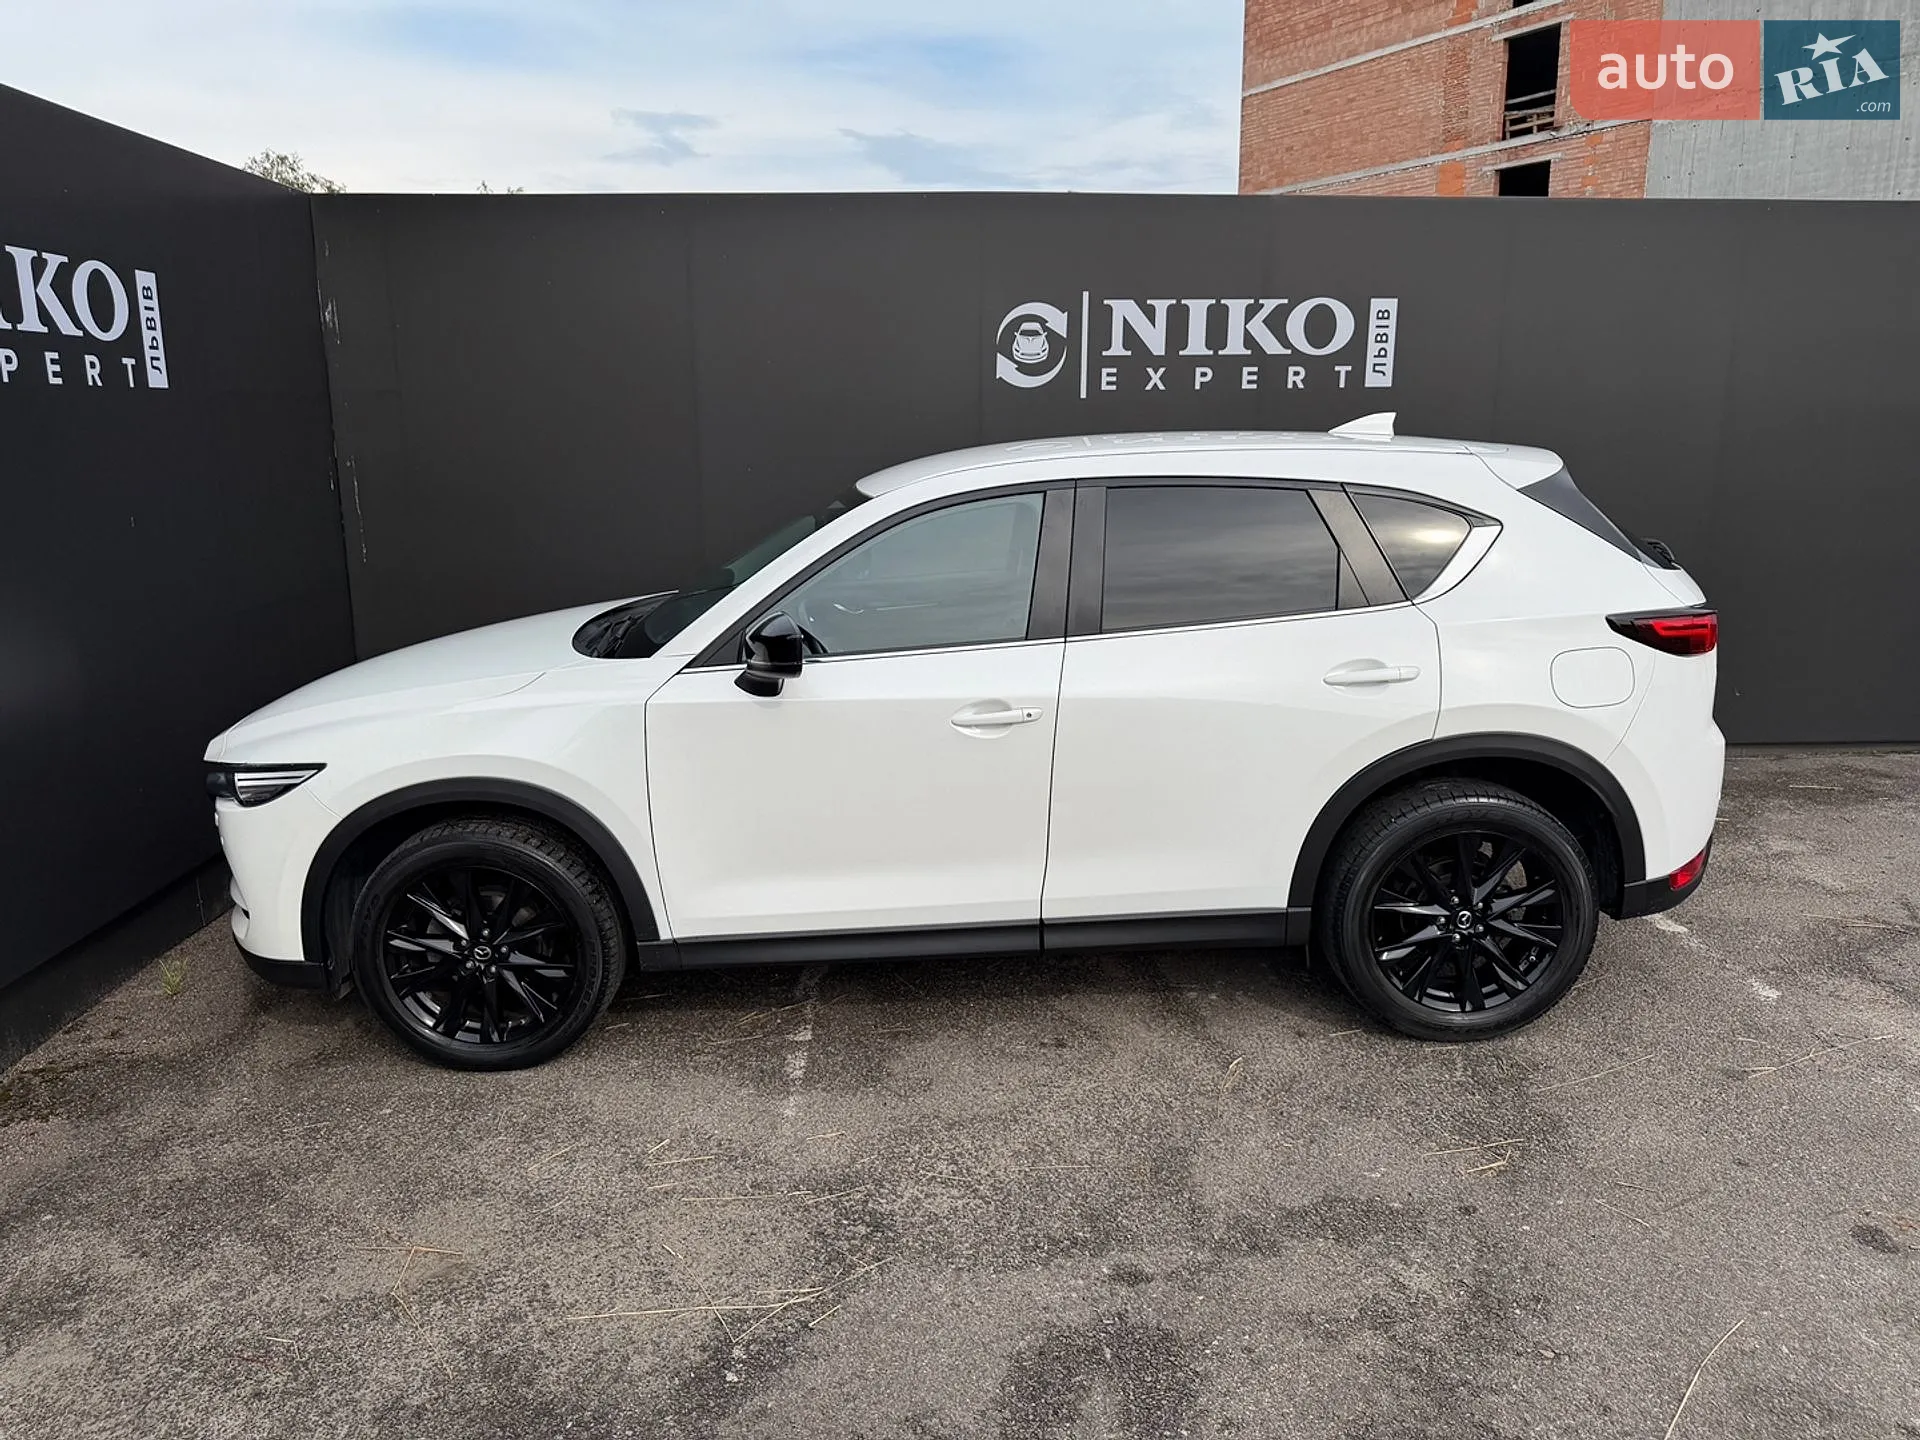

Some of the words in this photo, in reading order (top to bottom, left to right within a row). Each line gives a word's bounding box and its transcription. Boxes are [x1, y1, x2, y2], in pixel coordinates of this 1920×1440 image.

[142, 285, 163, 375] ЛЬВІВ
[1102, 297, 1355, 356] NIKO
[1371, 308, 1392, 377] ЛЬВІВ
[1101, 365, 1353, 391] EXPERT
